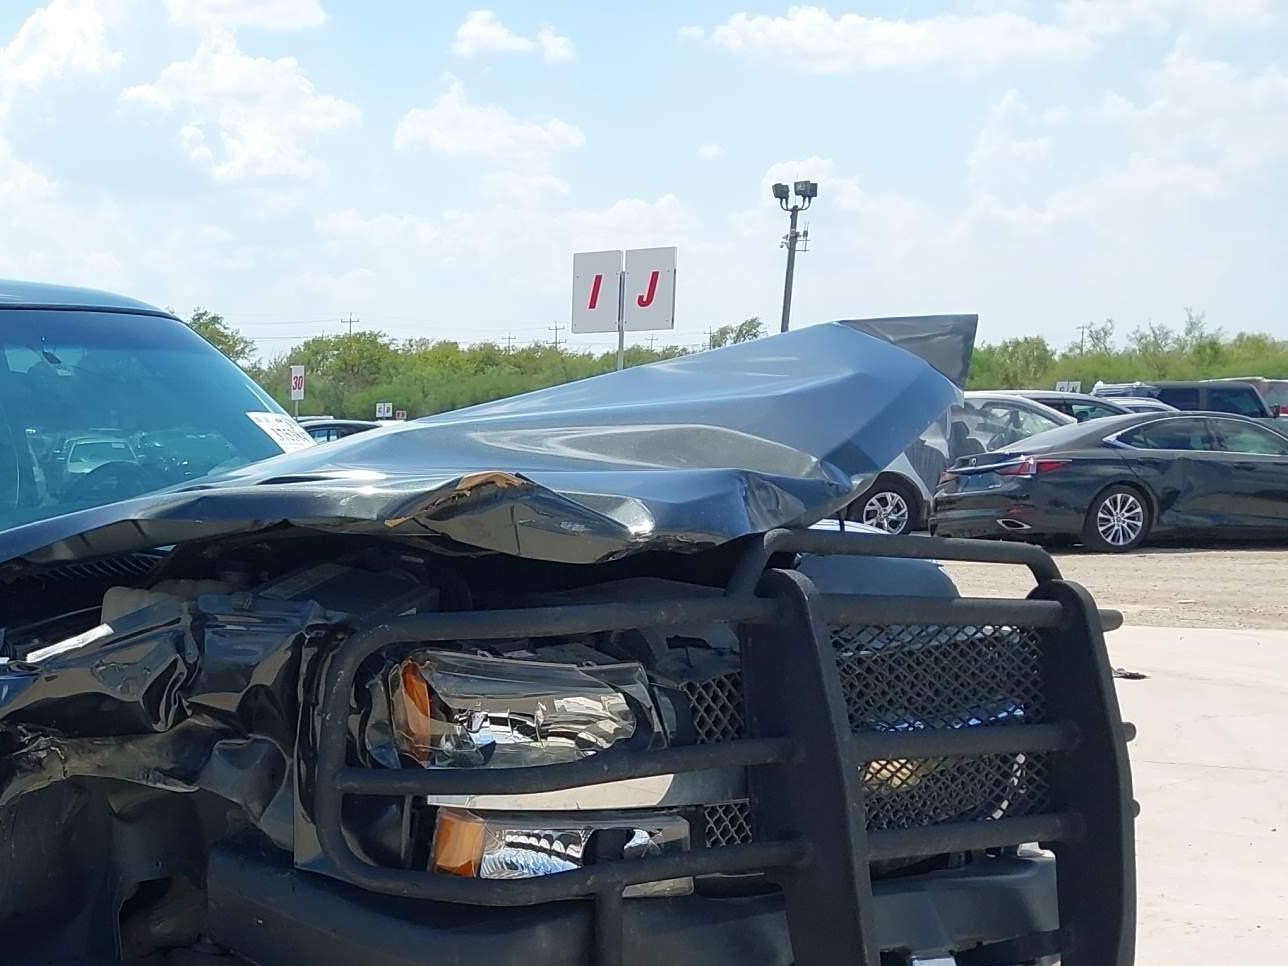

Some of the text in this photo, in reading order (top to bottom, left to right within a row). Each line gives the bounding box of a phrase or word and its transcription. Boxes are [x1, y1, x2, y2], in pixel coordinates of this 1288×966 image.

[587, 269, 661, 310] I J
[292, 376, 303, 390] 30
